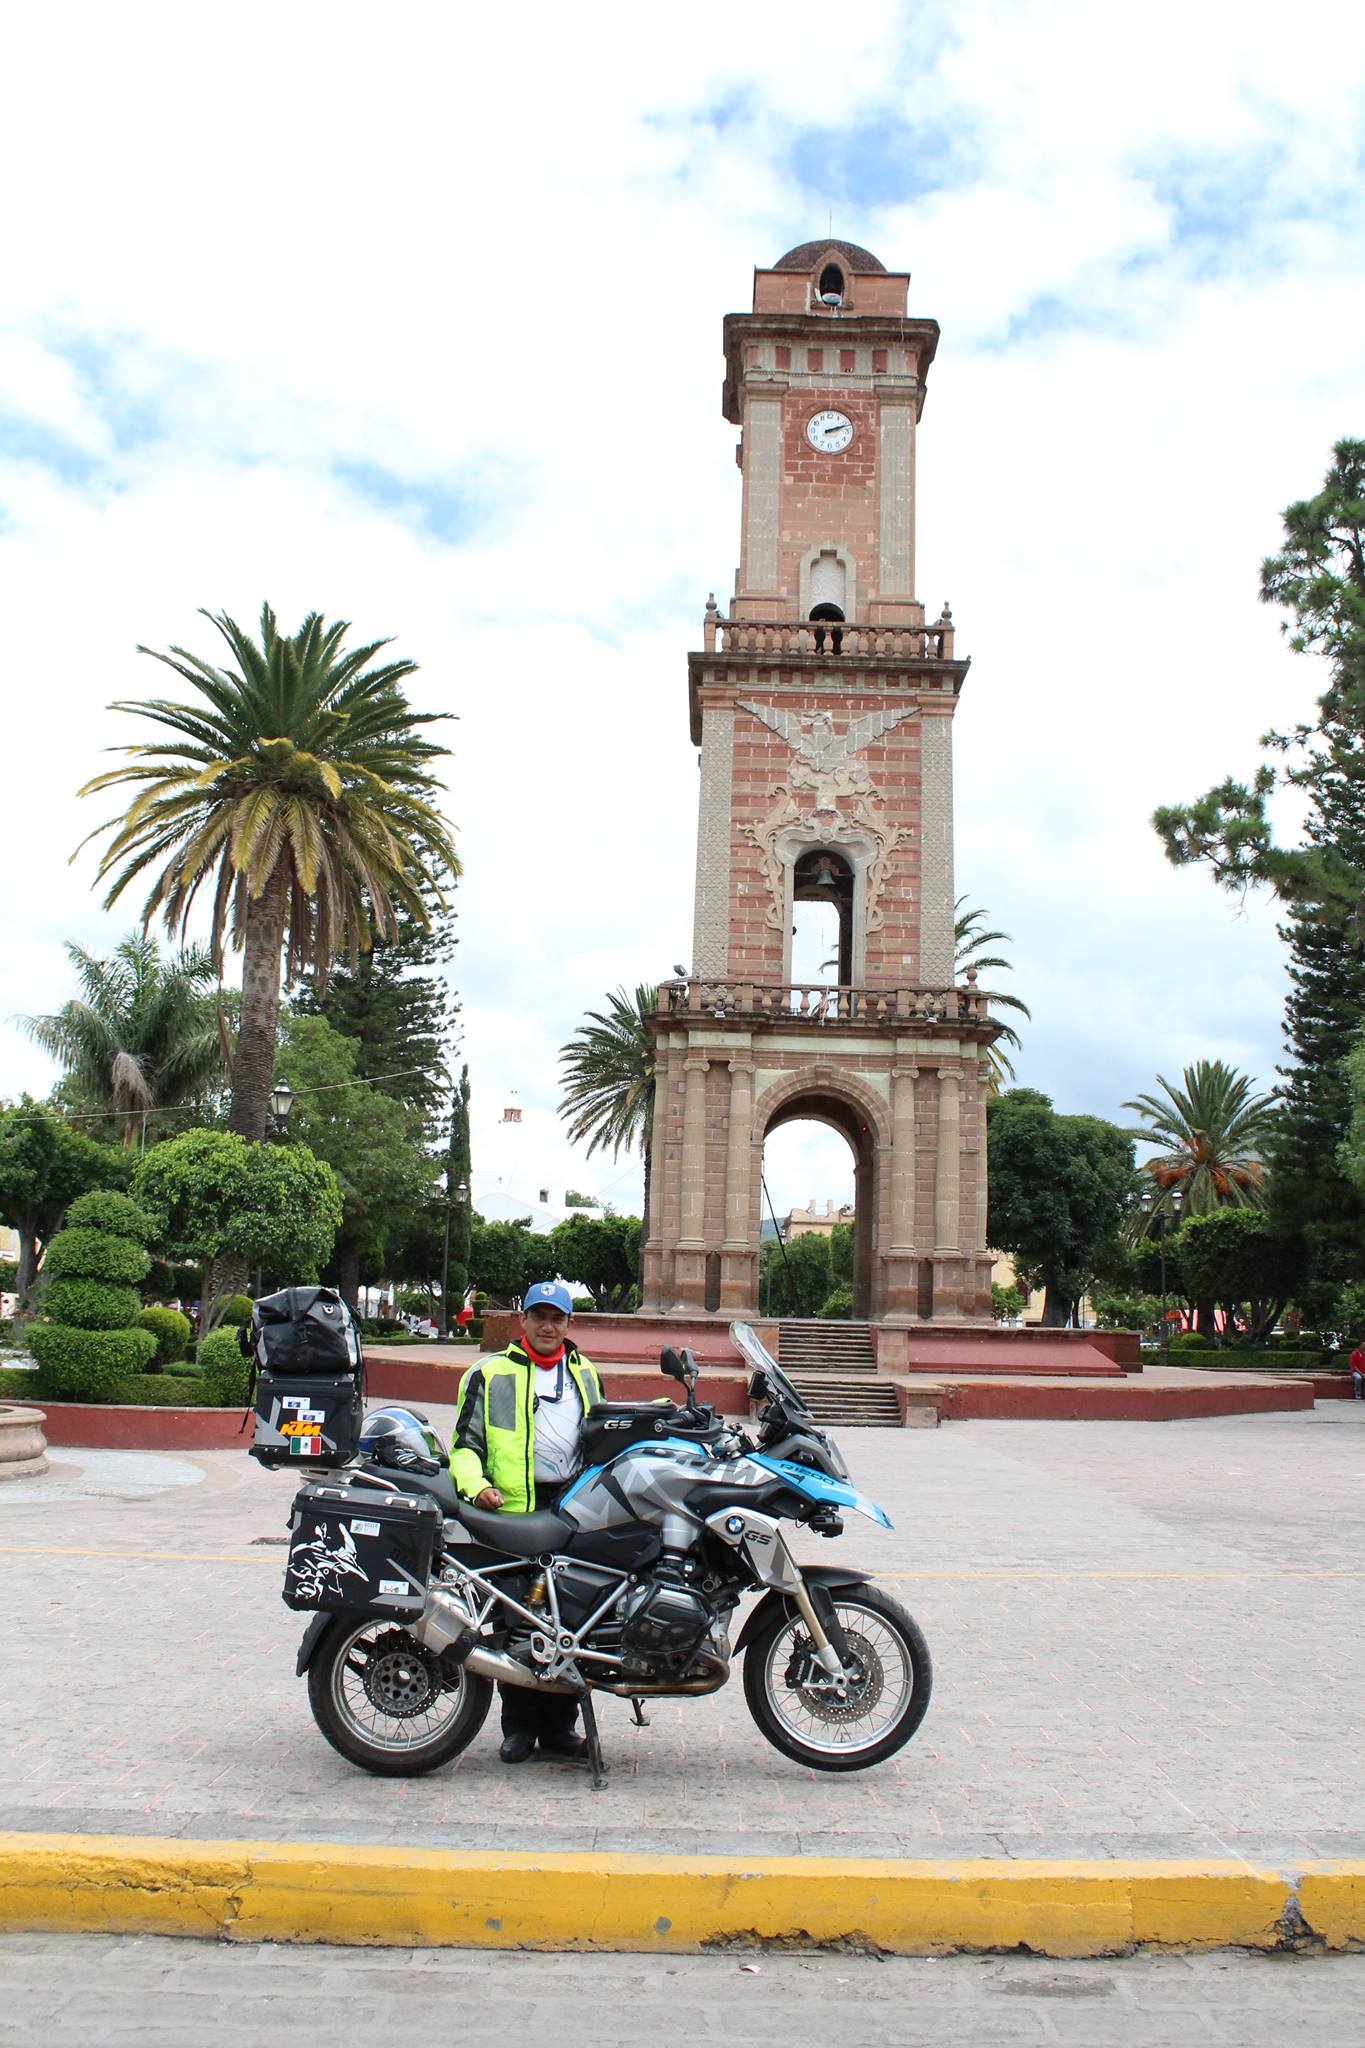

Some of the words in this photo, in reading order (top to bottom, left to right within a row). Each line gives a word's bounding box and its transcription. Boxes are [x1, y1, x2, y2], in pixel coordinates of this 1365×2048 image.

[279, 1420, 322, 1437] KTM
[603, 1419, 633, 1431] GS
[781, 1462, 835, 1486] R1200
[744, 1529, 773, 1545] GS
